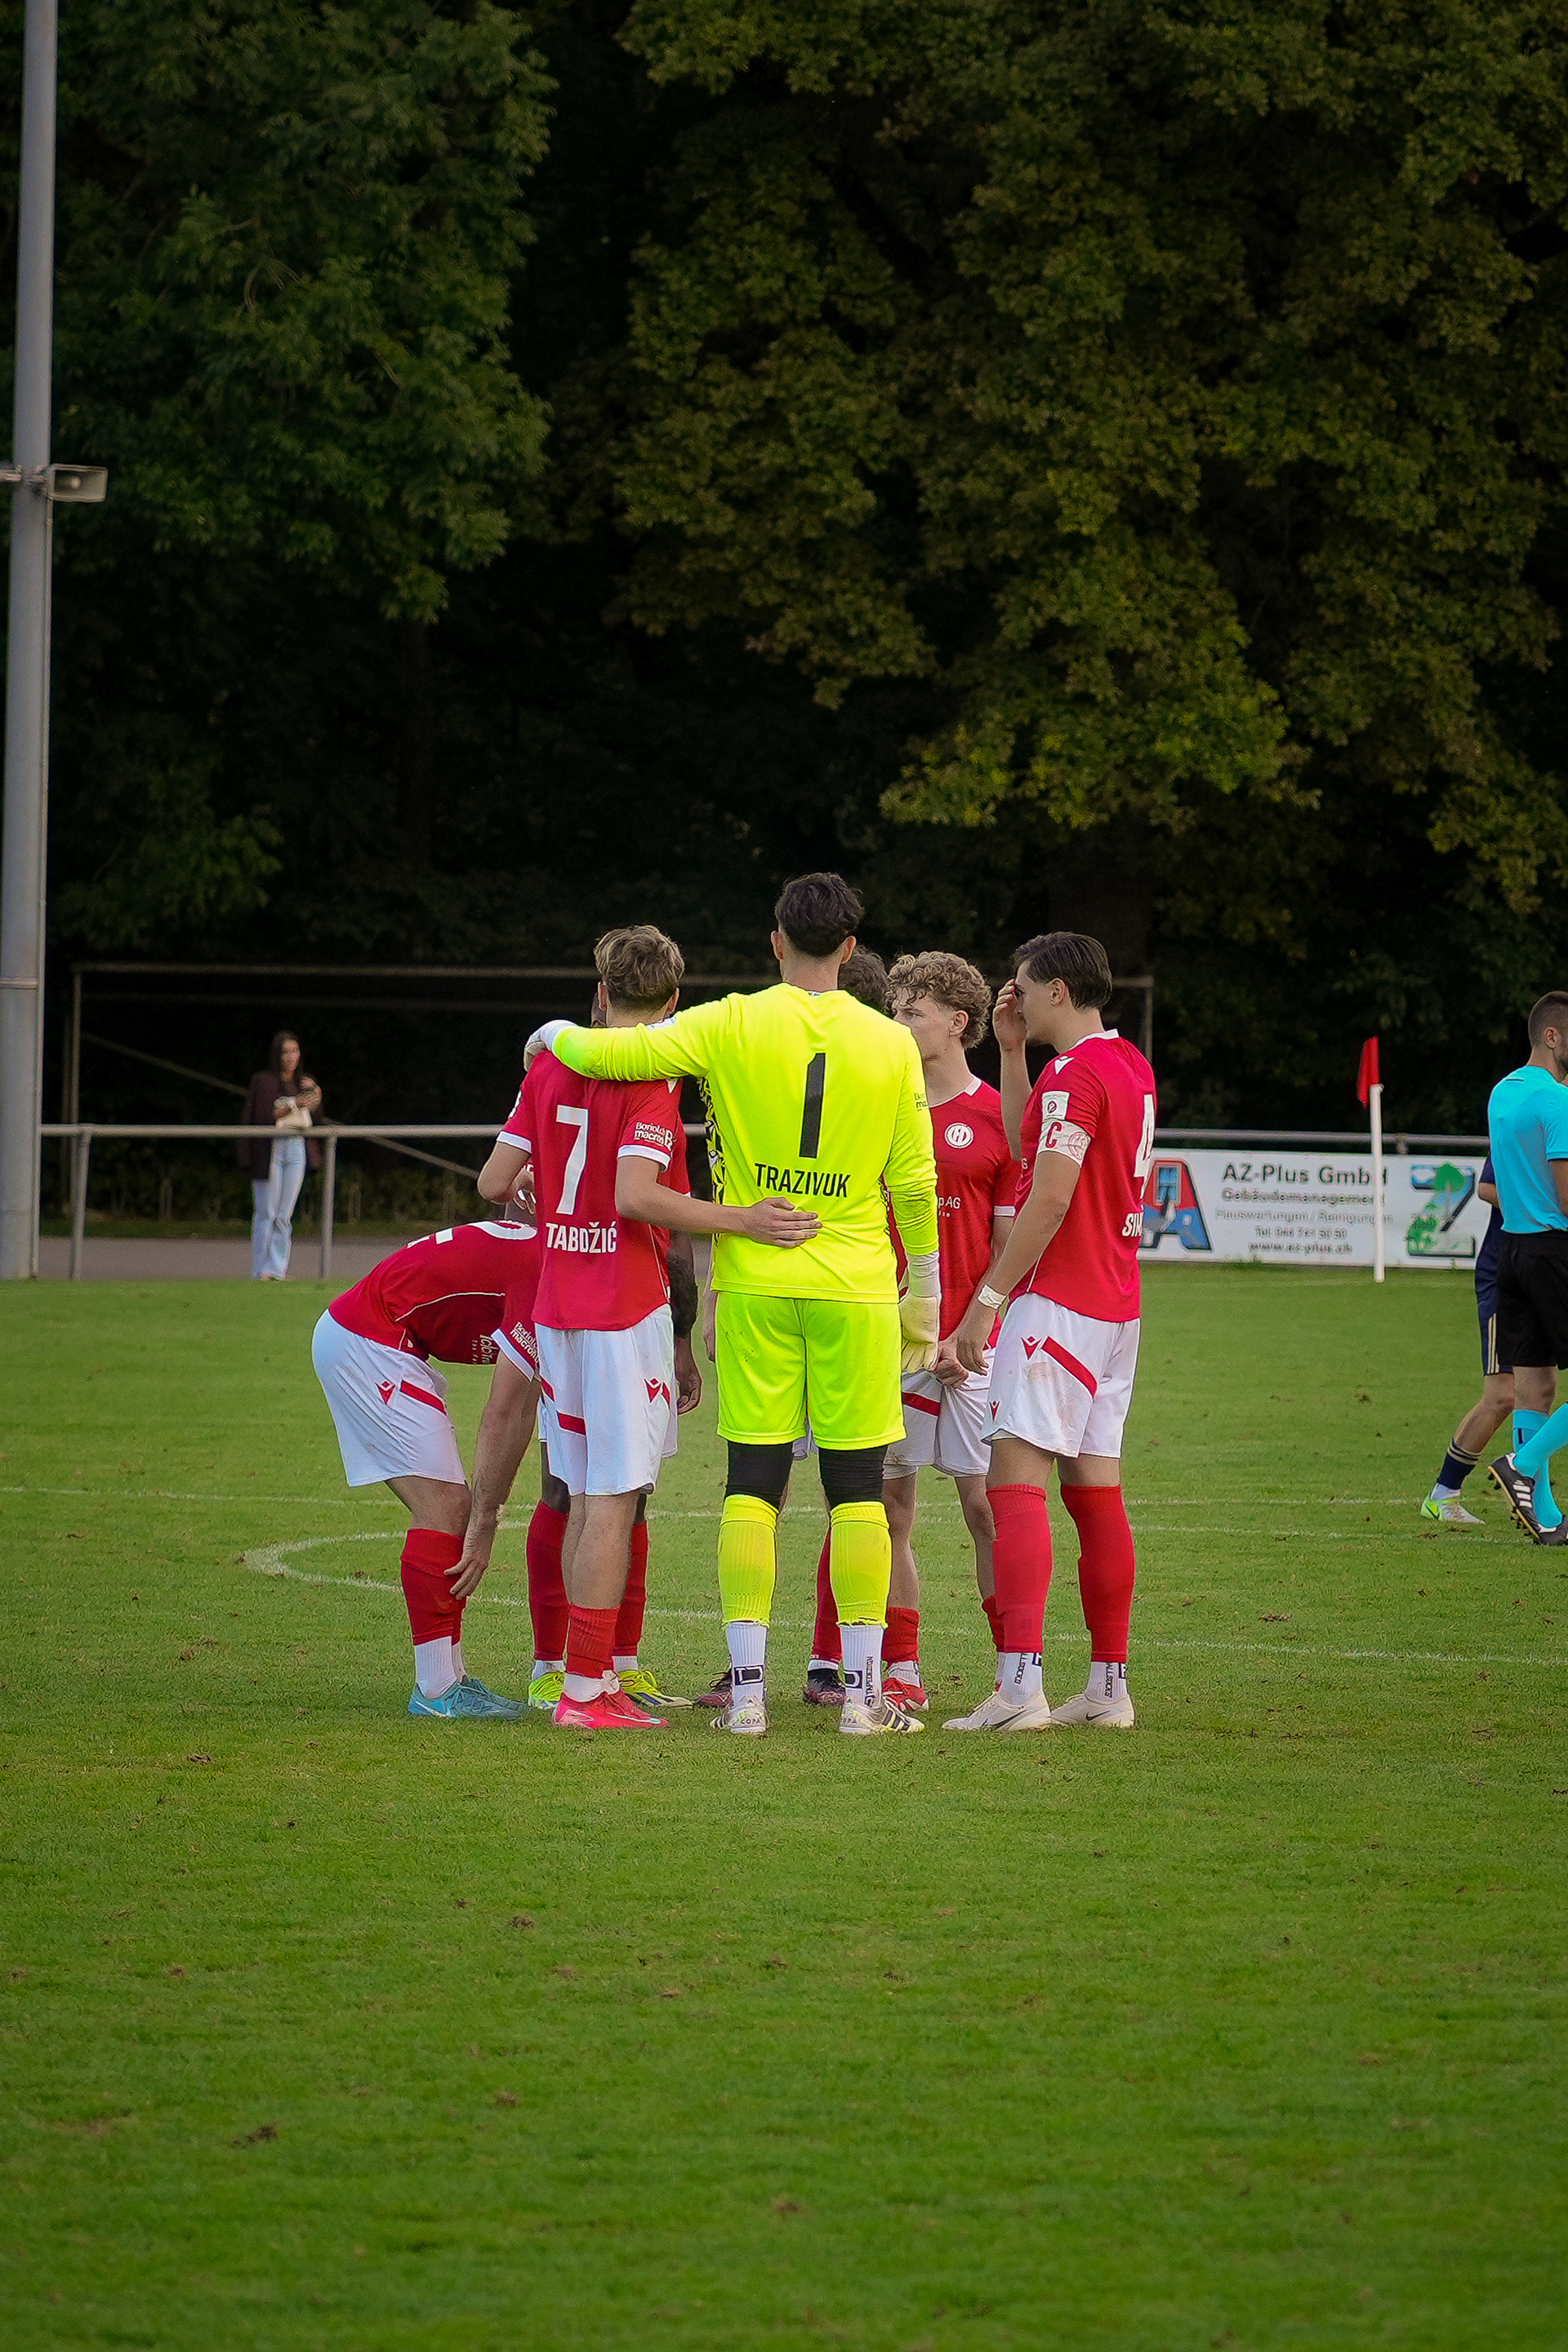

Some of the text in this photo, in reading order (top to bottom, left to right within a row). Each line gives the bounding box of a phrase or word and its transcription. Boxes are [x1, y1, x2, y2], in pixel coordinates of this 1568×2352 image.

[799, 1053, 826, 1159] 1
[1045, 1122, 1062, 1148] C
[555, 1104, 589, 1215] 7
[1223, 1164, 1309, 1183] AZ-Plus
[755, 1163, 851, 1198] TRAZIVUK
